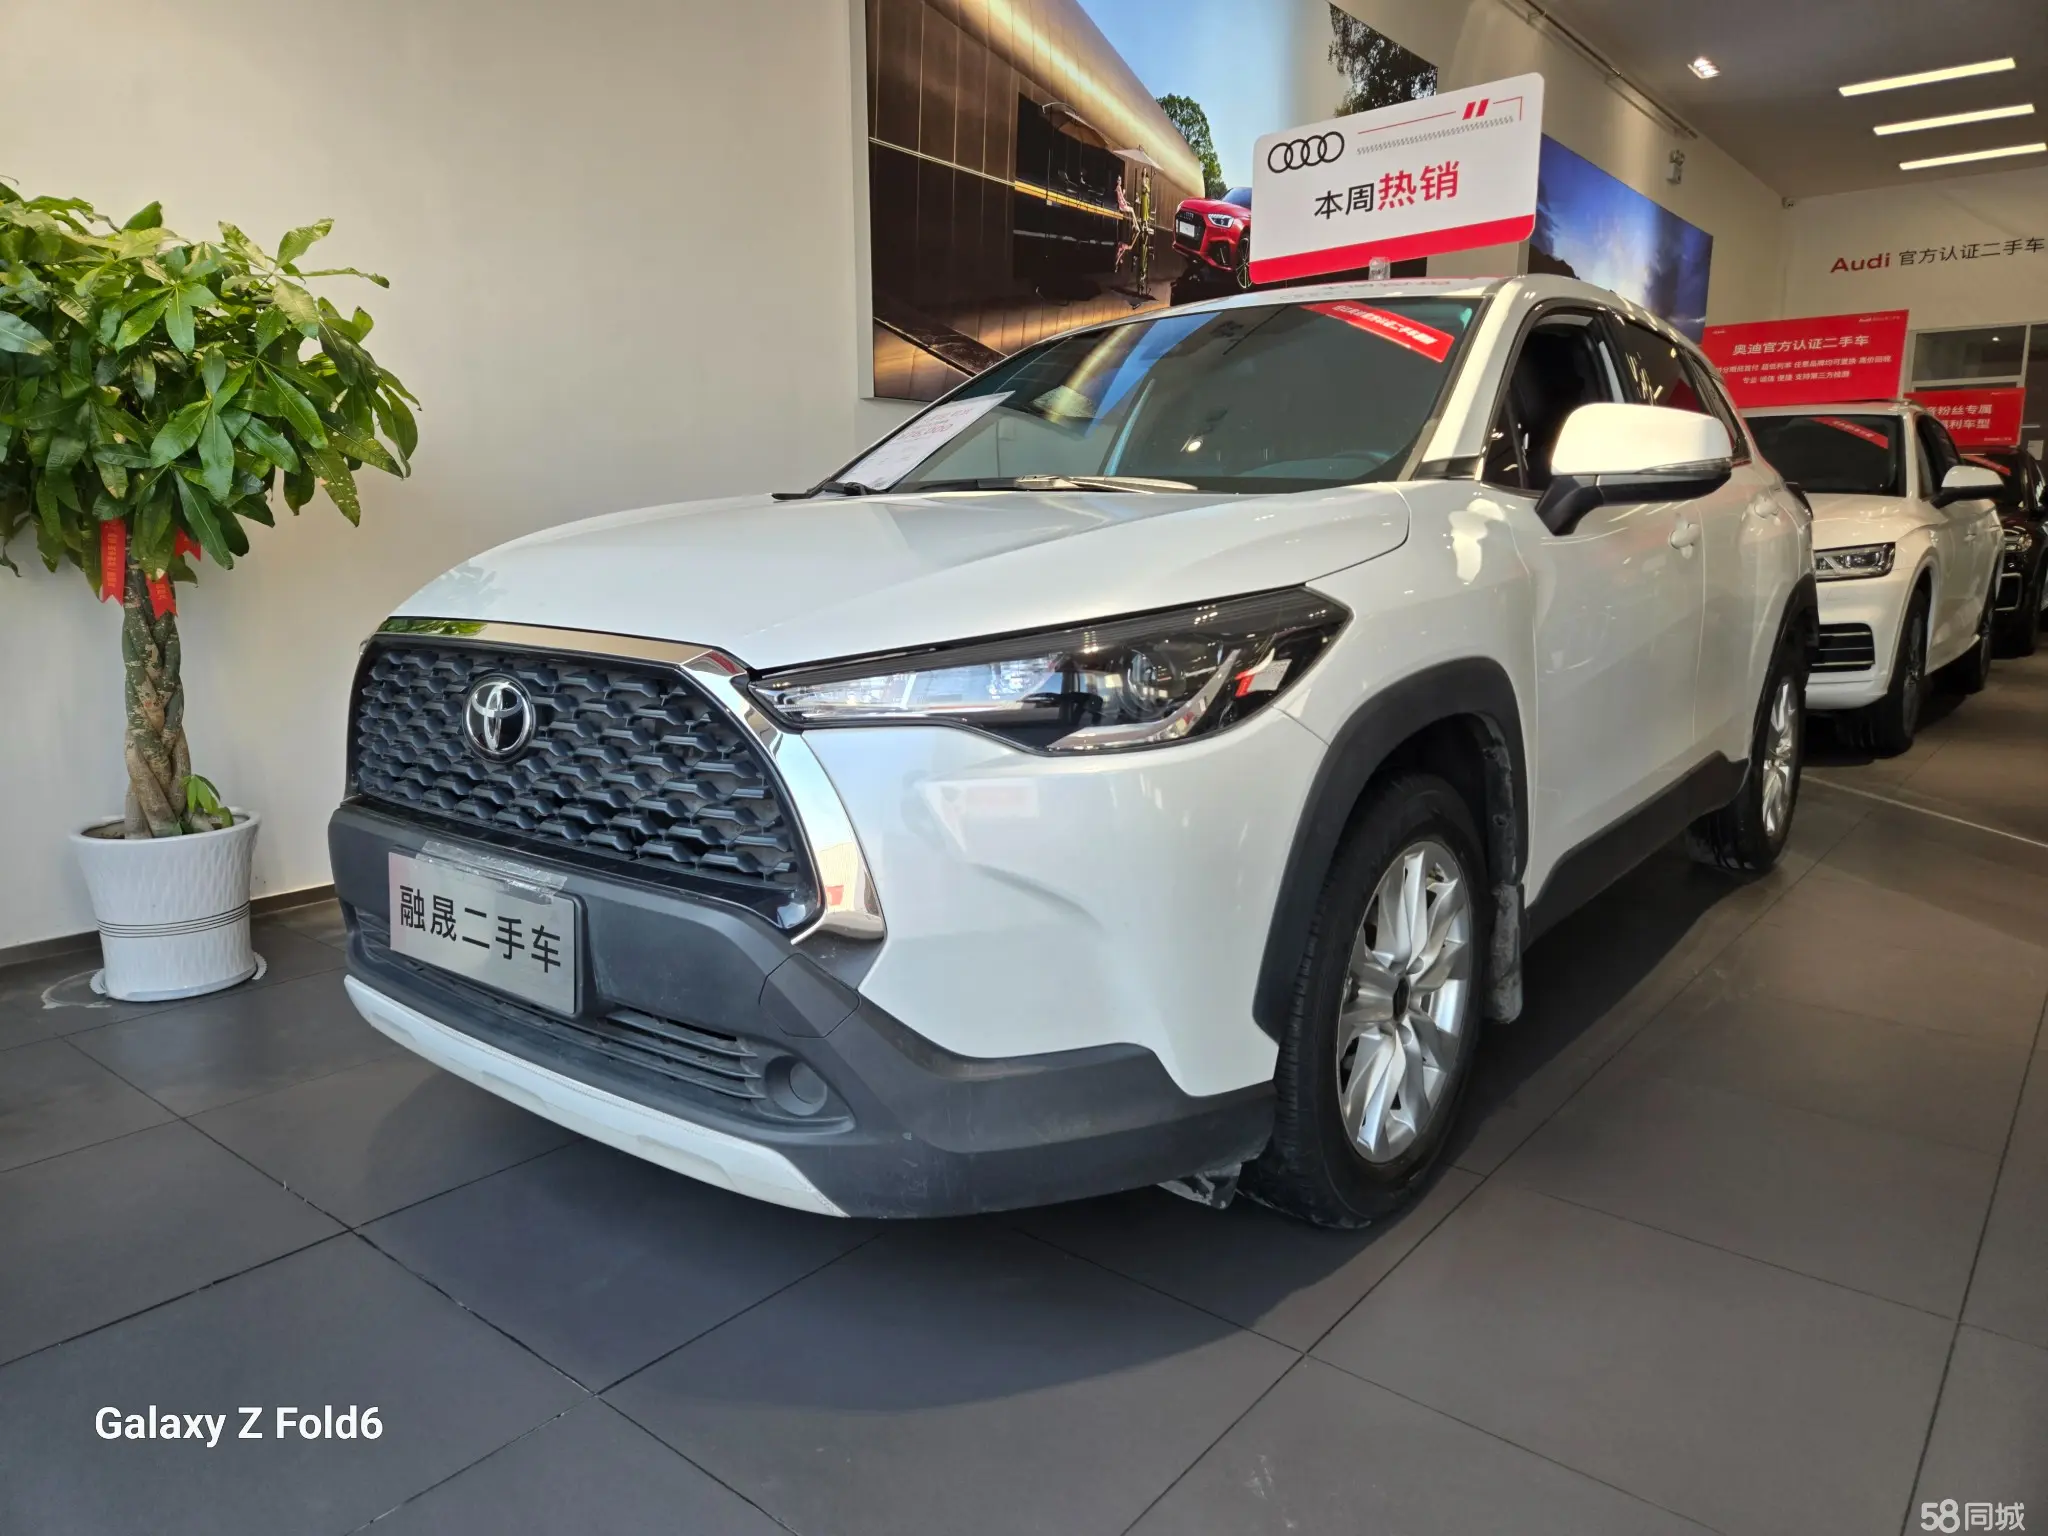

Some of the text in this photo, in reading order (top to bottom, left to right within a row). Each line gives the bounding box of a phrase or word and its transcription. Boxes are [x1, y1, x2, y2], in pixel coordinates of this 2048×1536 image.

[1314, 160, 1460, 219] 本周热销
[1830, 236, 2045, 273] Audi 官方认证二手车
[1732, 335, 1870, 356] 奥迪官方认证二手车
[400, 885, 561, 973] 融晟二手车
